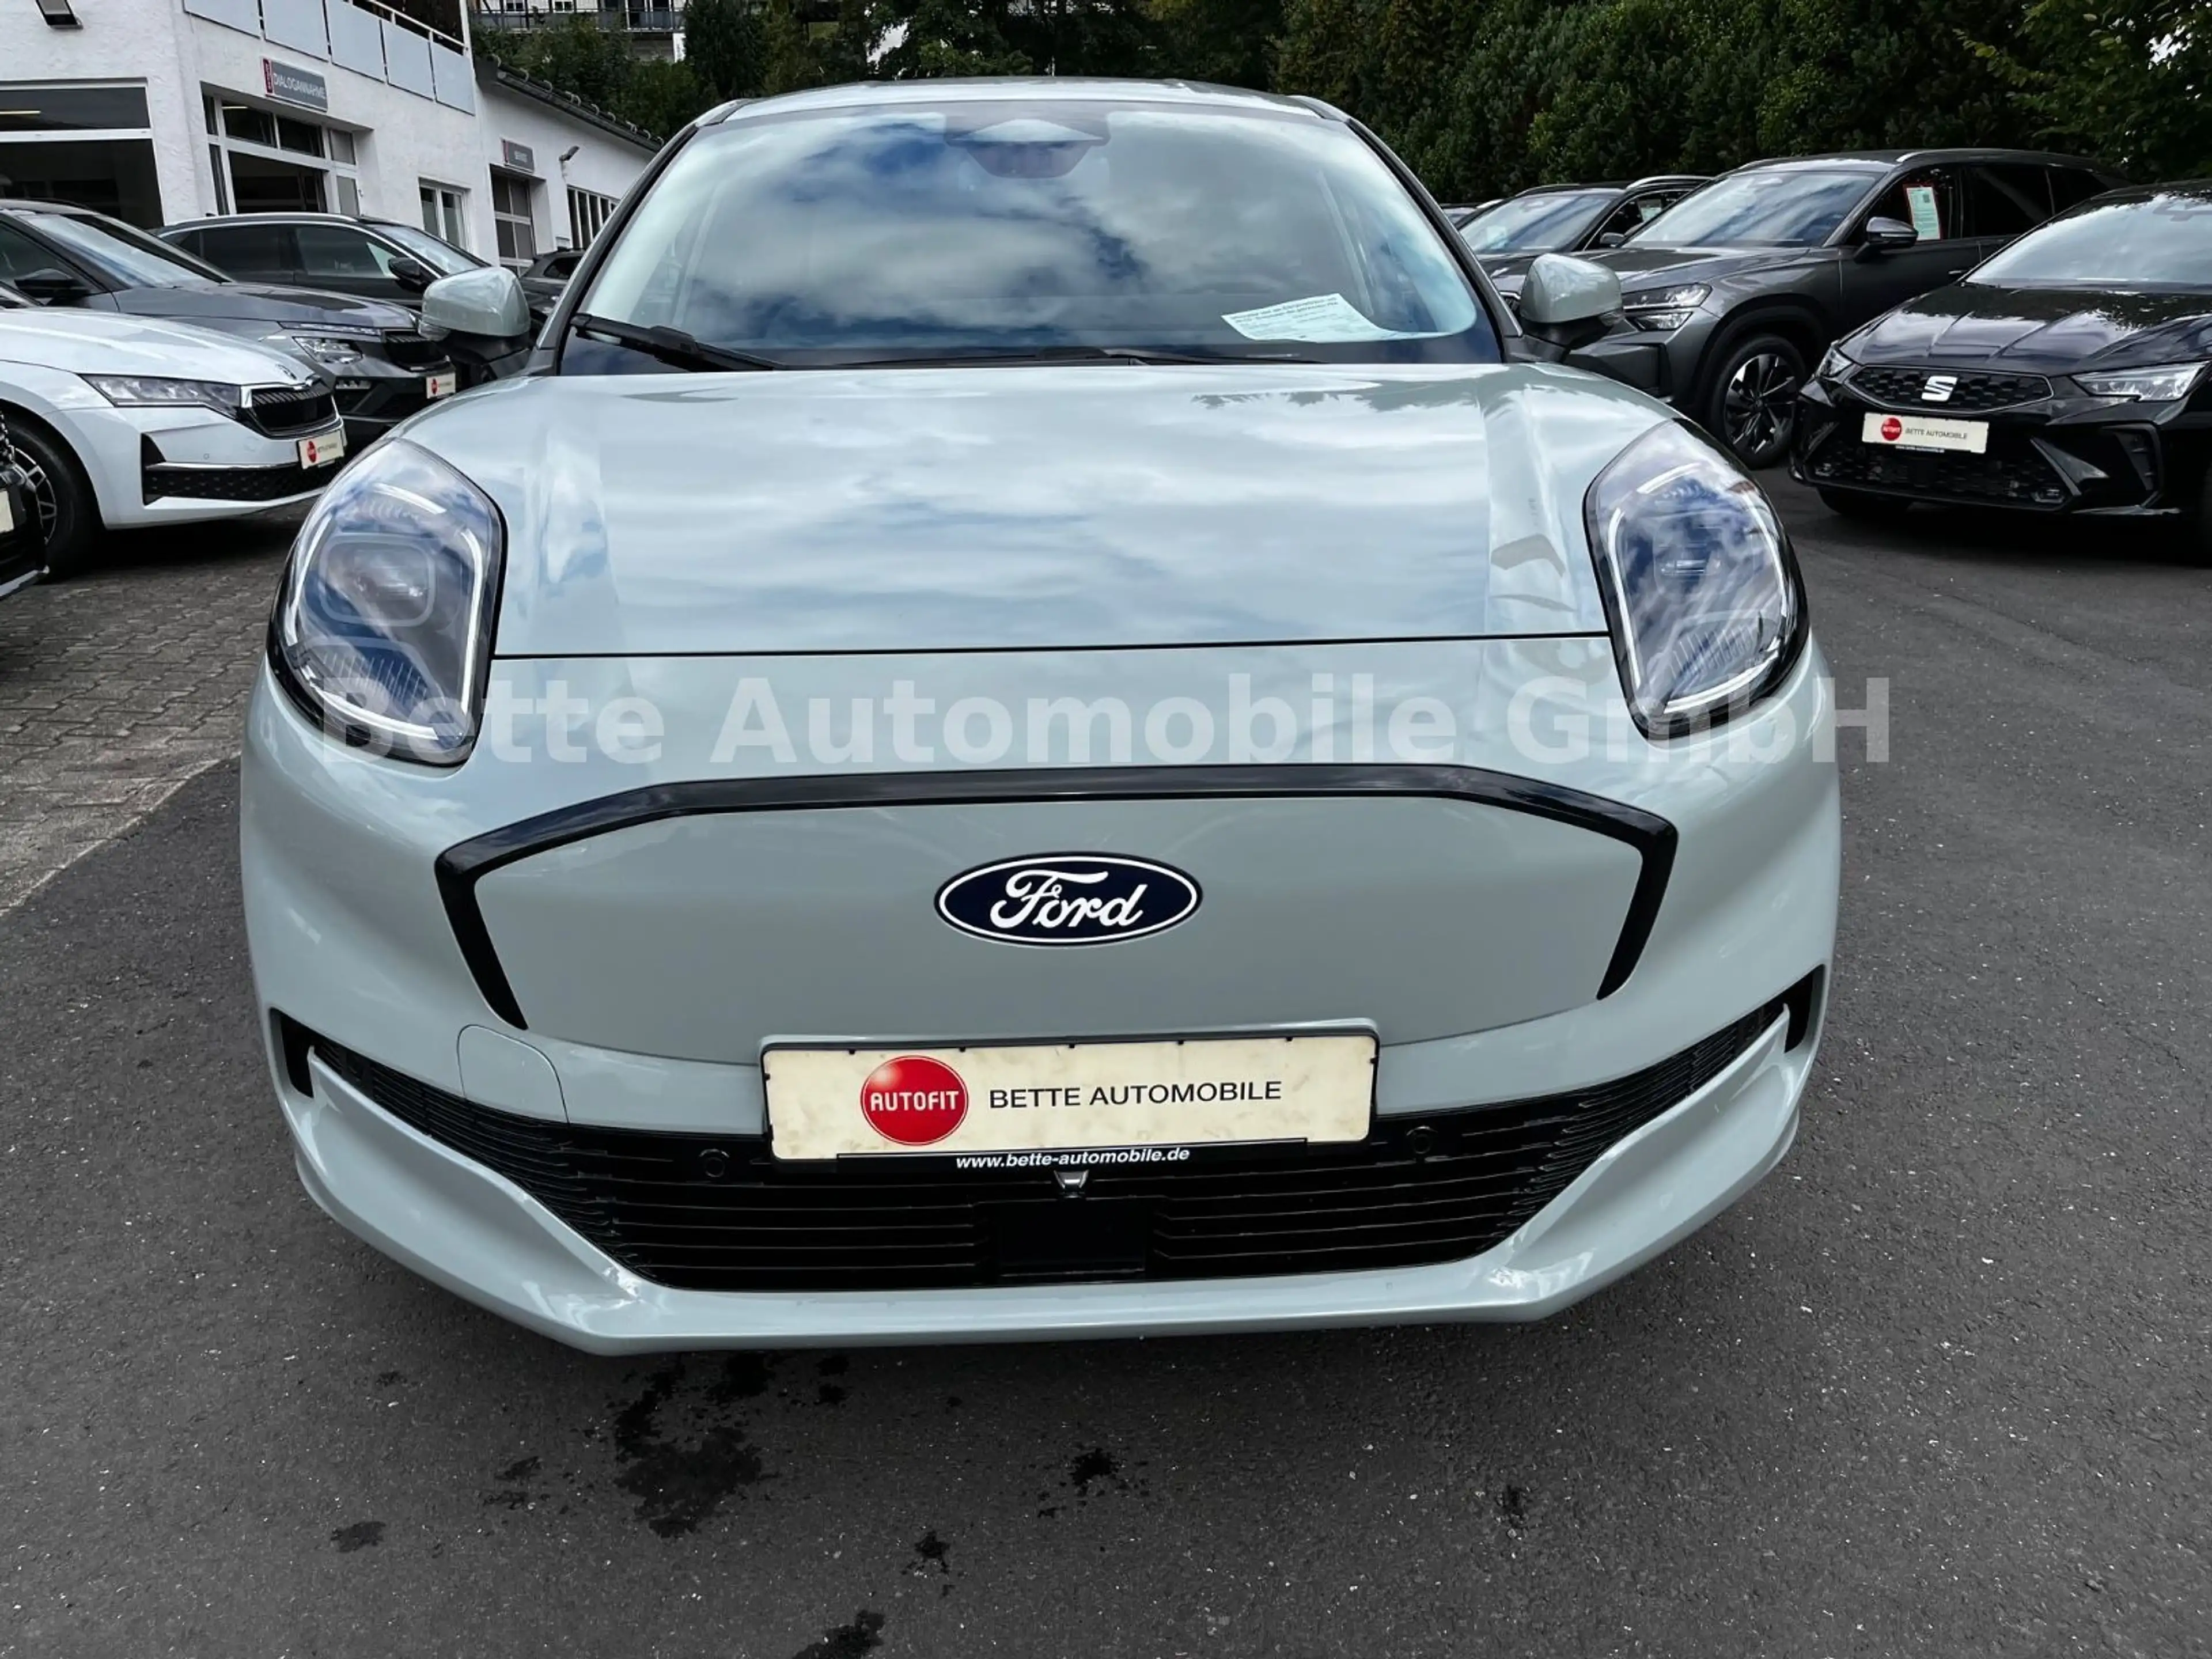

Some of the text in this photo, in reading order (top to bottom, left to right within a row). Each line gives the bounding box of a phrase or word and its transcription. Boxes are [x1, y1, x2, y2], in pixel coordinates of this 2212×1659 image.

[990, 870, 1148, 929] Ford
[870, 1090, 959, 1112] AUTOFIT
[989, 1081, 1282, 1109] BETTE AUTOMOBILE
[956, 1147, 1190, 1168] www.bette-automobile.de
